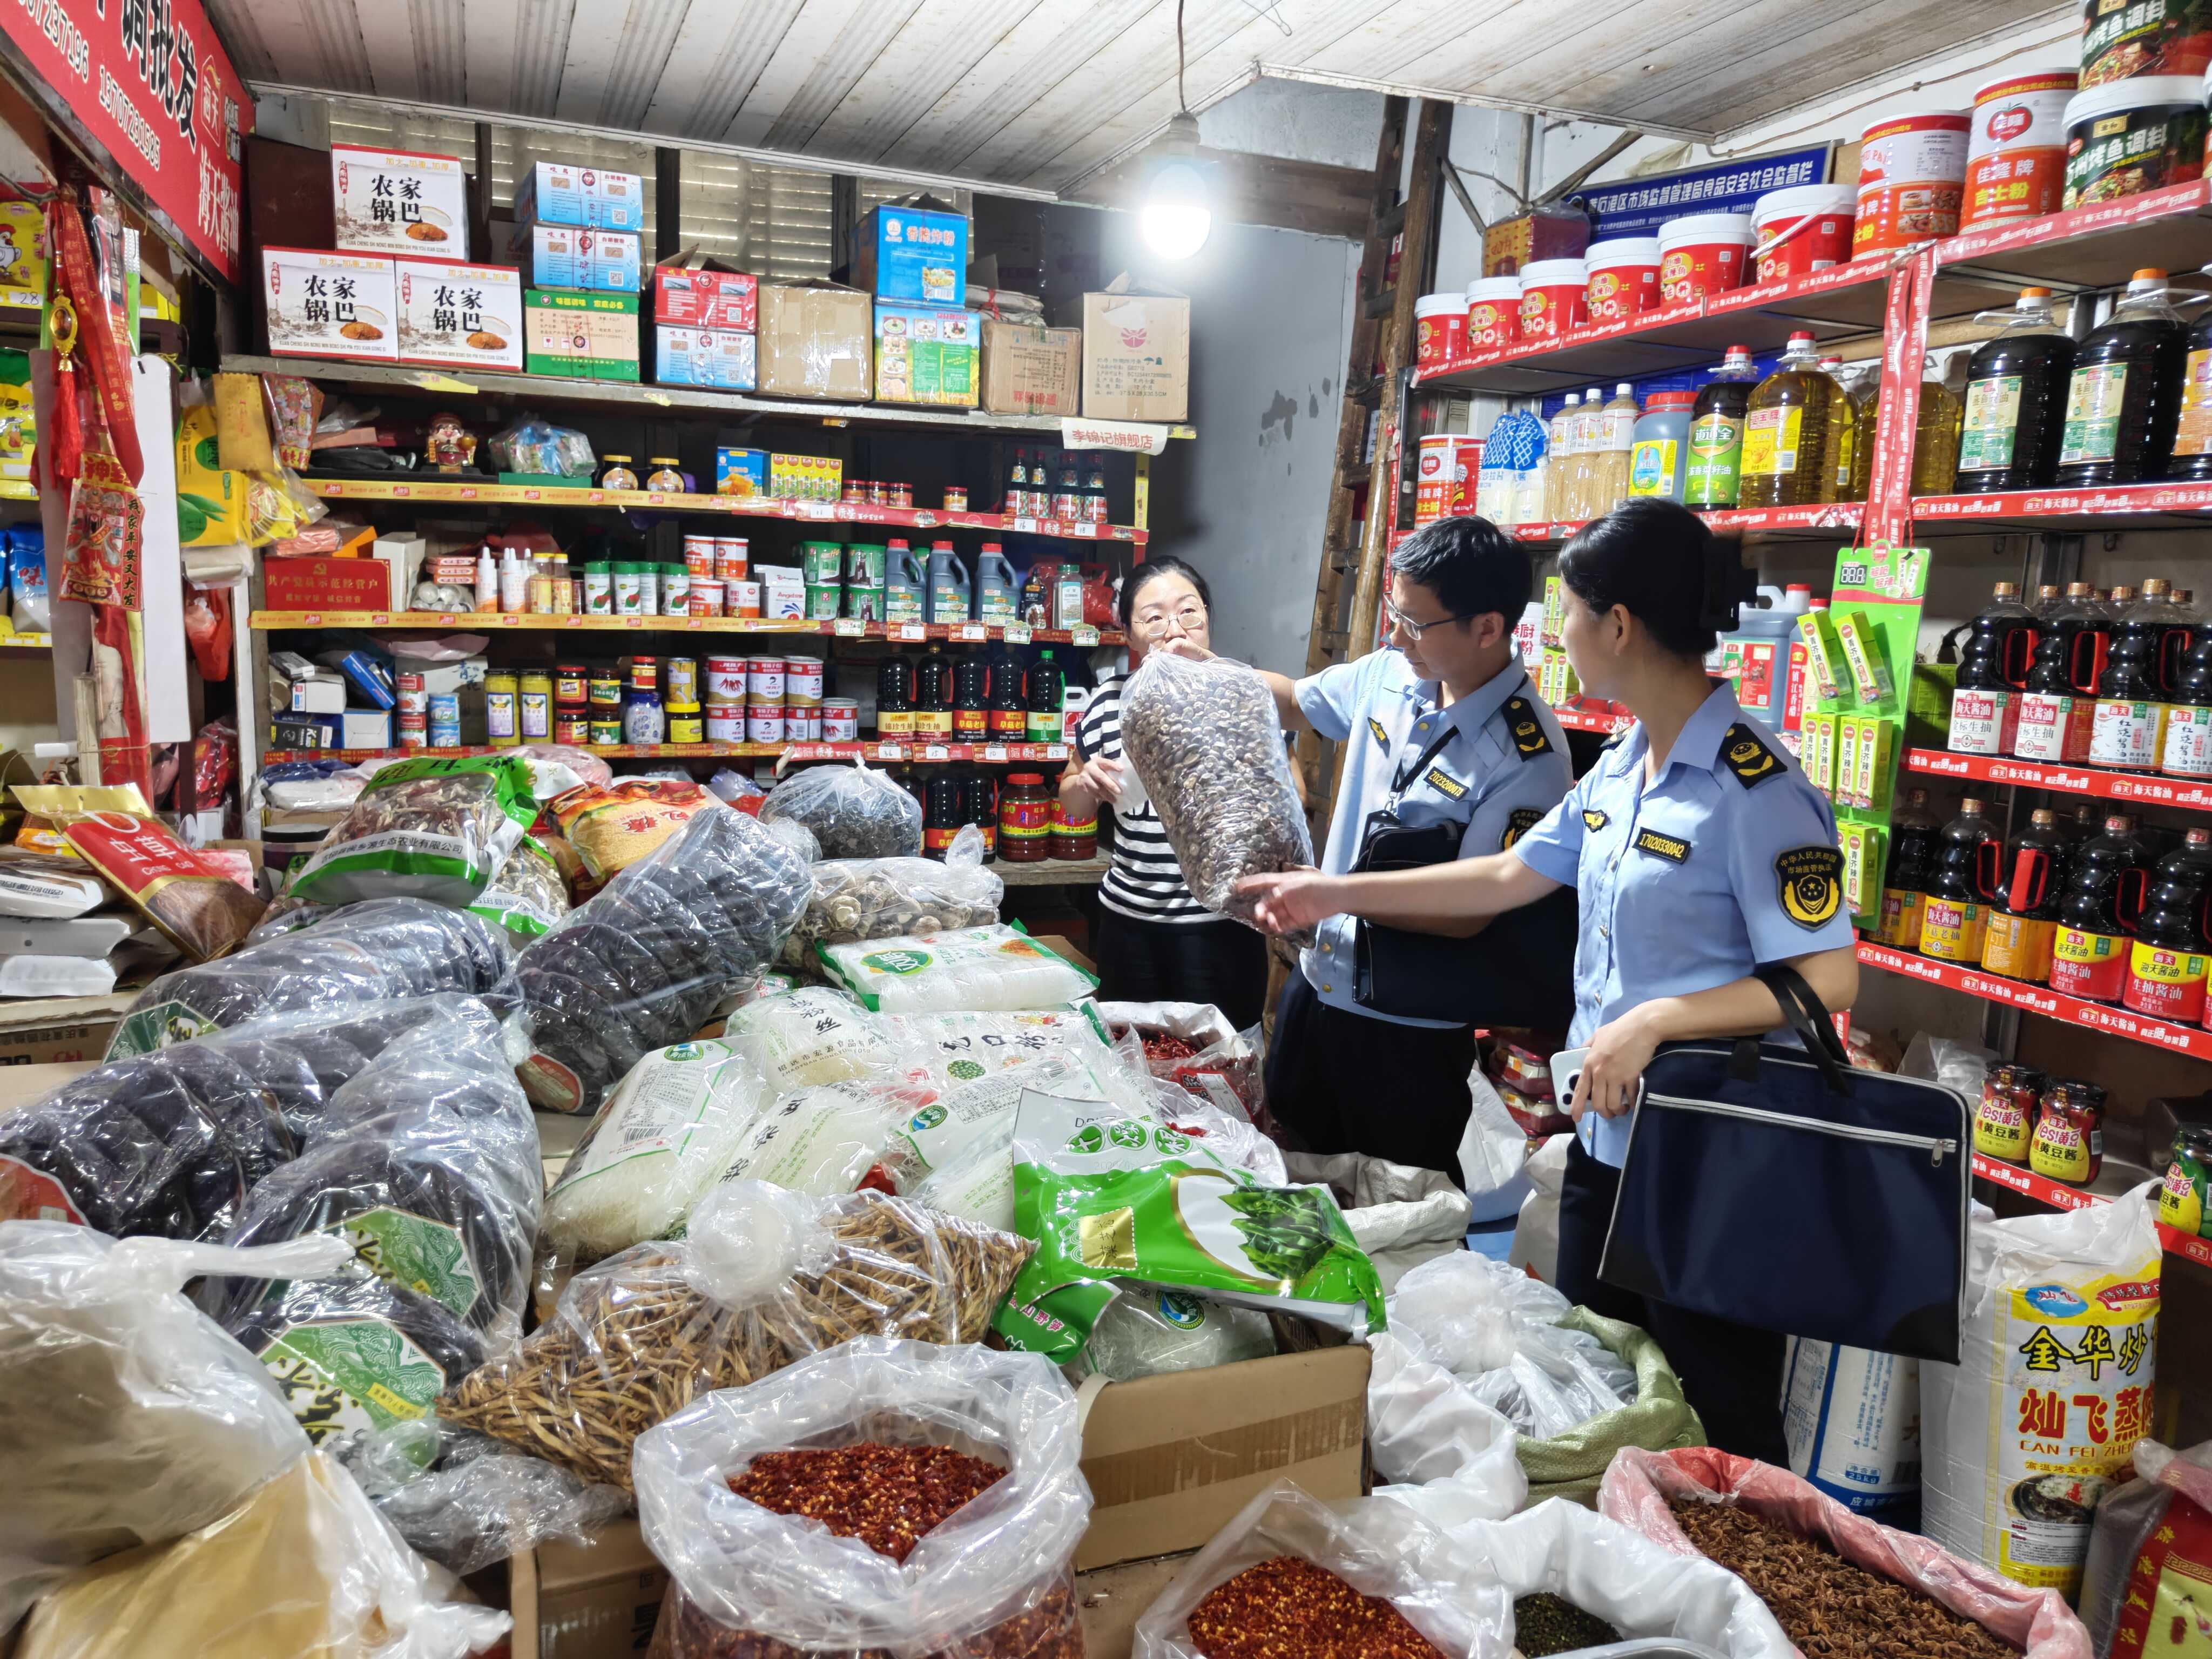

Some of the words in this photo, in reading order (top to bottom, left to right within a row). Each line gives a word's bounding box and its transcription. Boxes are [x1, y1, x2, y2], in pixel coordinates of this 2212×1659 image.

[97, 0, 197, 153] 调批发
[1977, 159, 2035, 184] 佳隆牌
[371, 174, 422, 200] 农家
[1589, 160, 1813, 215] 黄石港区市场监督管理局食品安全社会监督栏
[1974, 181, 2029, 207] 吉士粉
[198, 144, 238, 267] 海天酱油
[370, 198, 423, 223] 锅巴
[304, 274, 357, 300] 农家
[20, 292, 41, 305] 28
[434, 285, 484, 310] 农家
[304, 298, 359, 323] 锅巴
[433, 308, 483, 333] 锅巴
[1072, 429, 1154, 449] 李锦记旗舰店
[1694, 427, 1733, 442] 道道全
[1928, 502, 1959, 514] 海天酱油
[2044, 497, 2079, 509] 海天酱油
[837, 506, 857, 520] 质量
[1044, 522, 1060, 536] 质量
[123, 499, 140, 607] 我家平安又大发
[18, 565, 45, 587] 味
[268, 574, 378, 589] 共产党员示范经营户
[1808, 636, 1823, 663] 青芥辣
[1846, 639, 1862, 665] 青芥辣
[1955, 702, 1991, 716] 海天酱油
[2021, 705, 2054, 721] 海天酱油
[1820, 737, 1829, 765] 青芥辣
[1842, 740, 1853, 768] 青芥辣
[1861, 742, 1871, 771] 青芥辣
[2008, 768, 2042, 782] 海天酱油
[2134, 783, 2173, 799] 海天酱油
[1638, 833, 1685, 858] 17020330042
[1781, 851, 1837, 868] 中华人民共和国
[1788, 864, 1832, 874] 市场监管执法
[1850, 849, 1858, 877] 青芥辣
[1927, 909, 1960, 926] 海天酱油
[2068, 935, 2083, 945] 海天
[2058, 943, 2089, 957] 海天酱油
[2154, 953, 2174, 965] 海天
[1874, 952, 1902, 968] 海天酱油
[2053, 958, 2092, 980] 生抽酱油
[2140, 962, 2181, 977] 海天酱油
[1980, 981, 2011, 999] 海天酱油
[2133, 978, 2183, 1001] 生抽酱油
[2100, 1014, 2136, 1033] 海天酱油
[1992, 1098, 2010, 1110] 海天
[1984, 1122, 2021, 1141] 黄豆酱
[2049, 1117, 2067, 1129] 海天
[2039, 1142, 2078, 1161] 黄豆酱
[2019, 1324, 2159, 1381] 金华炒
[2019, 1440, 2060, 1456] CAN
[2069, 1446, 2096, 1458] FEI
[1847, 1473, 1878, 1484] 25kg
[1849, 1464, 1879, 1476] 净含量
